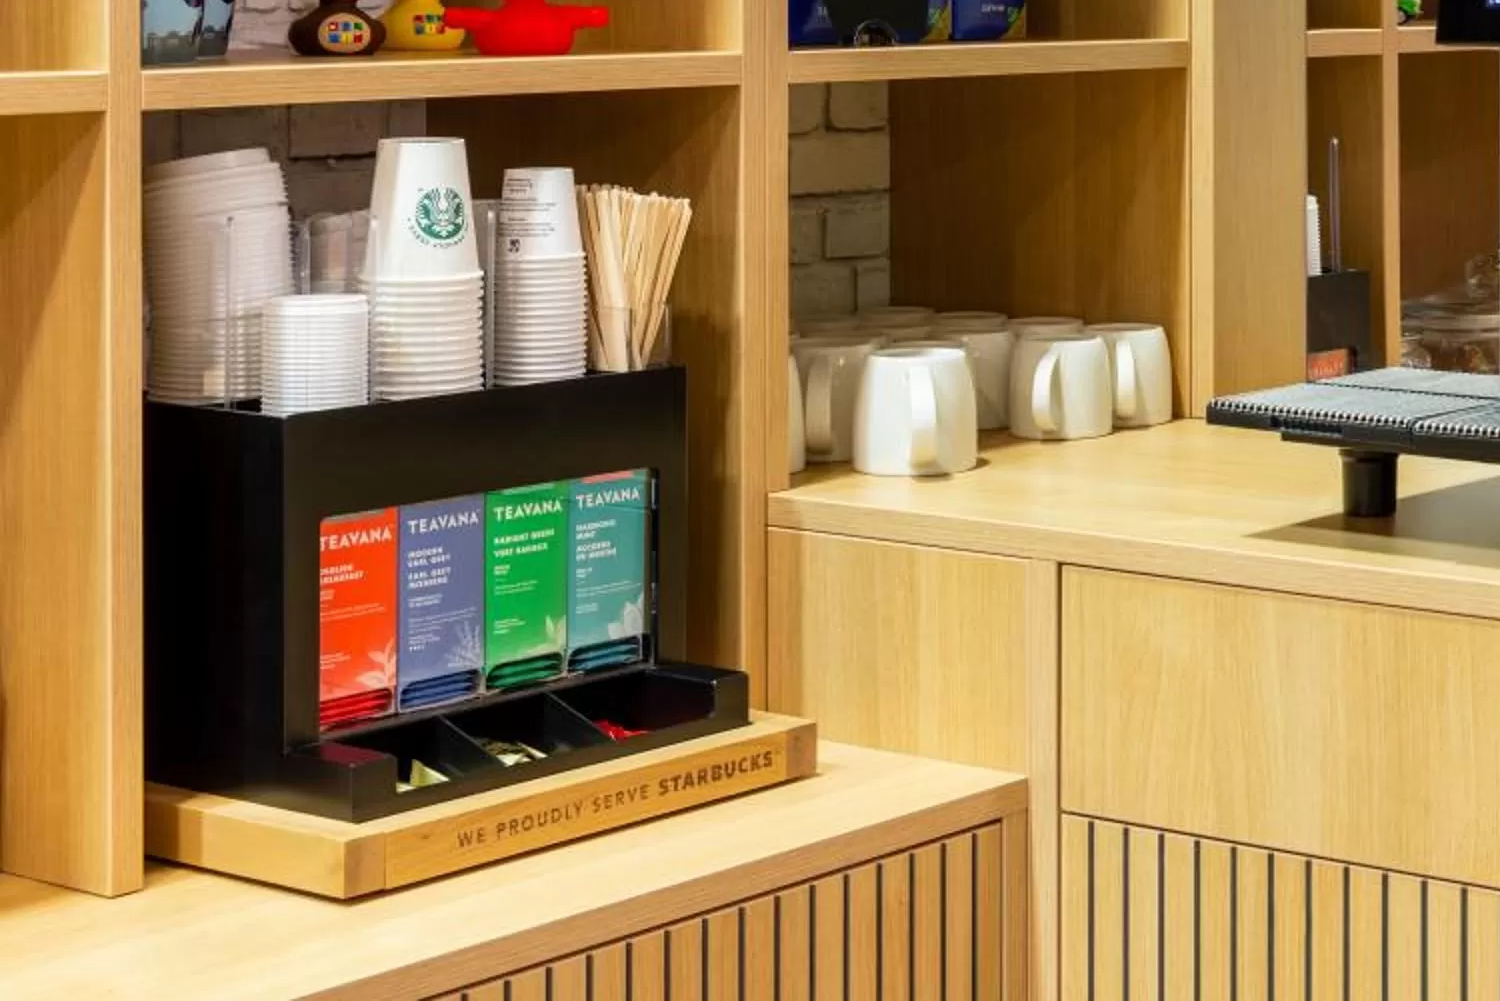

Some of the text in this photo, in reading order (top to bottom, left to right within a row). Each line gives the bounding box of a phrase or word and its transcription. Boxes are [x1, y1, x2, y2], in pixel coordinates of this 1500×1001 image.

[493, 498, 563, 522] TEAVANA
[575, 486, 640, 511] TEAVANA
[407, 510, 480, 535] TEAVANA
[456, 750, 773, 848] WE PROUDLY SERVE STARBUCKS
